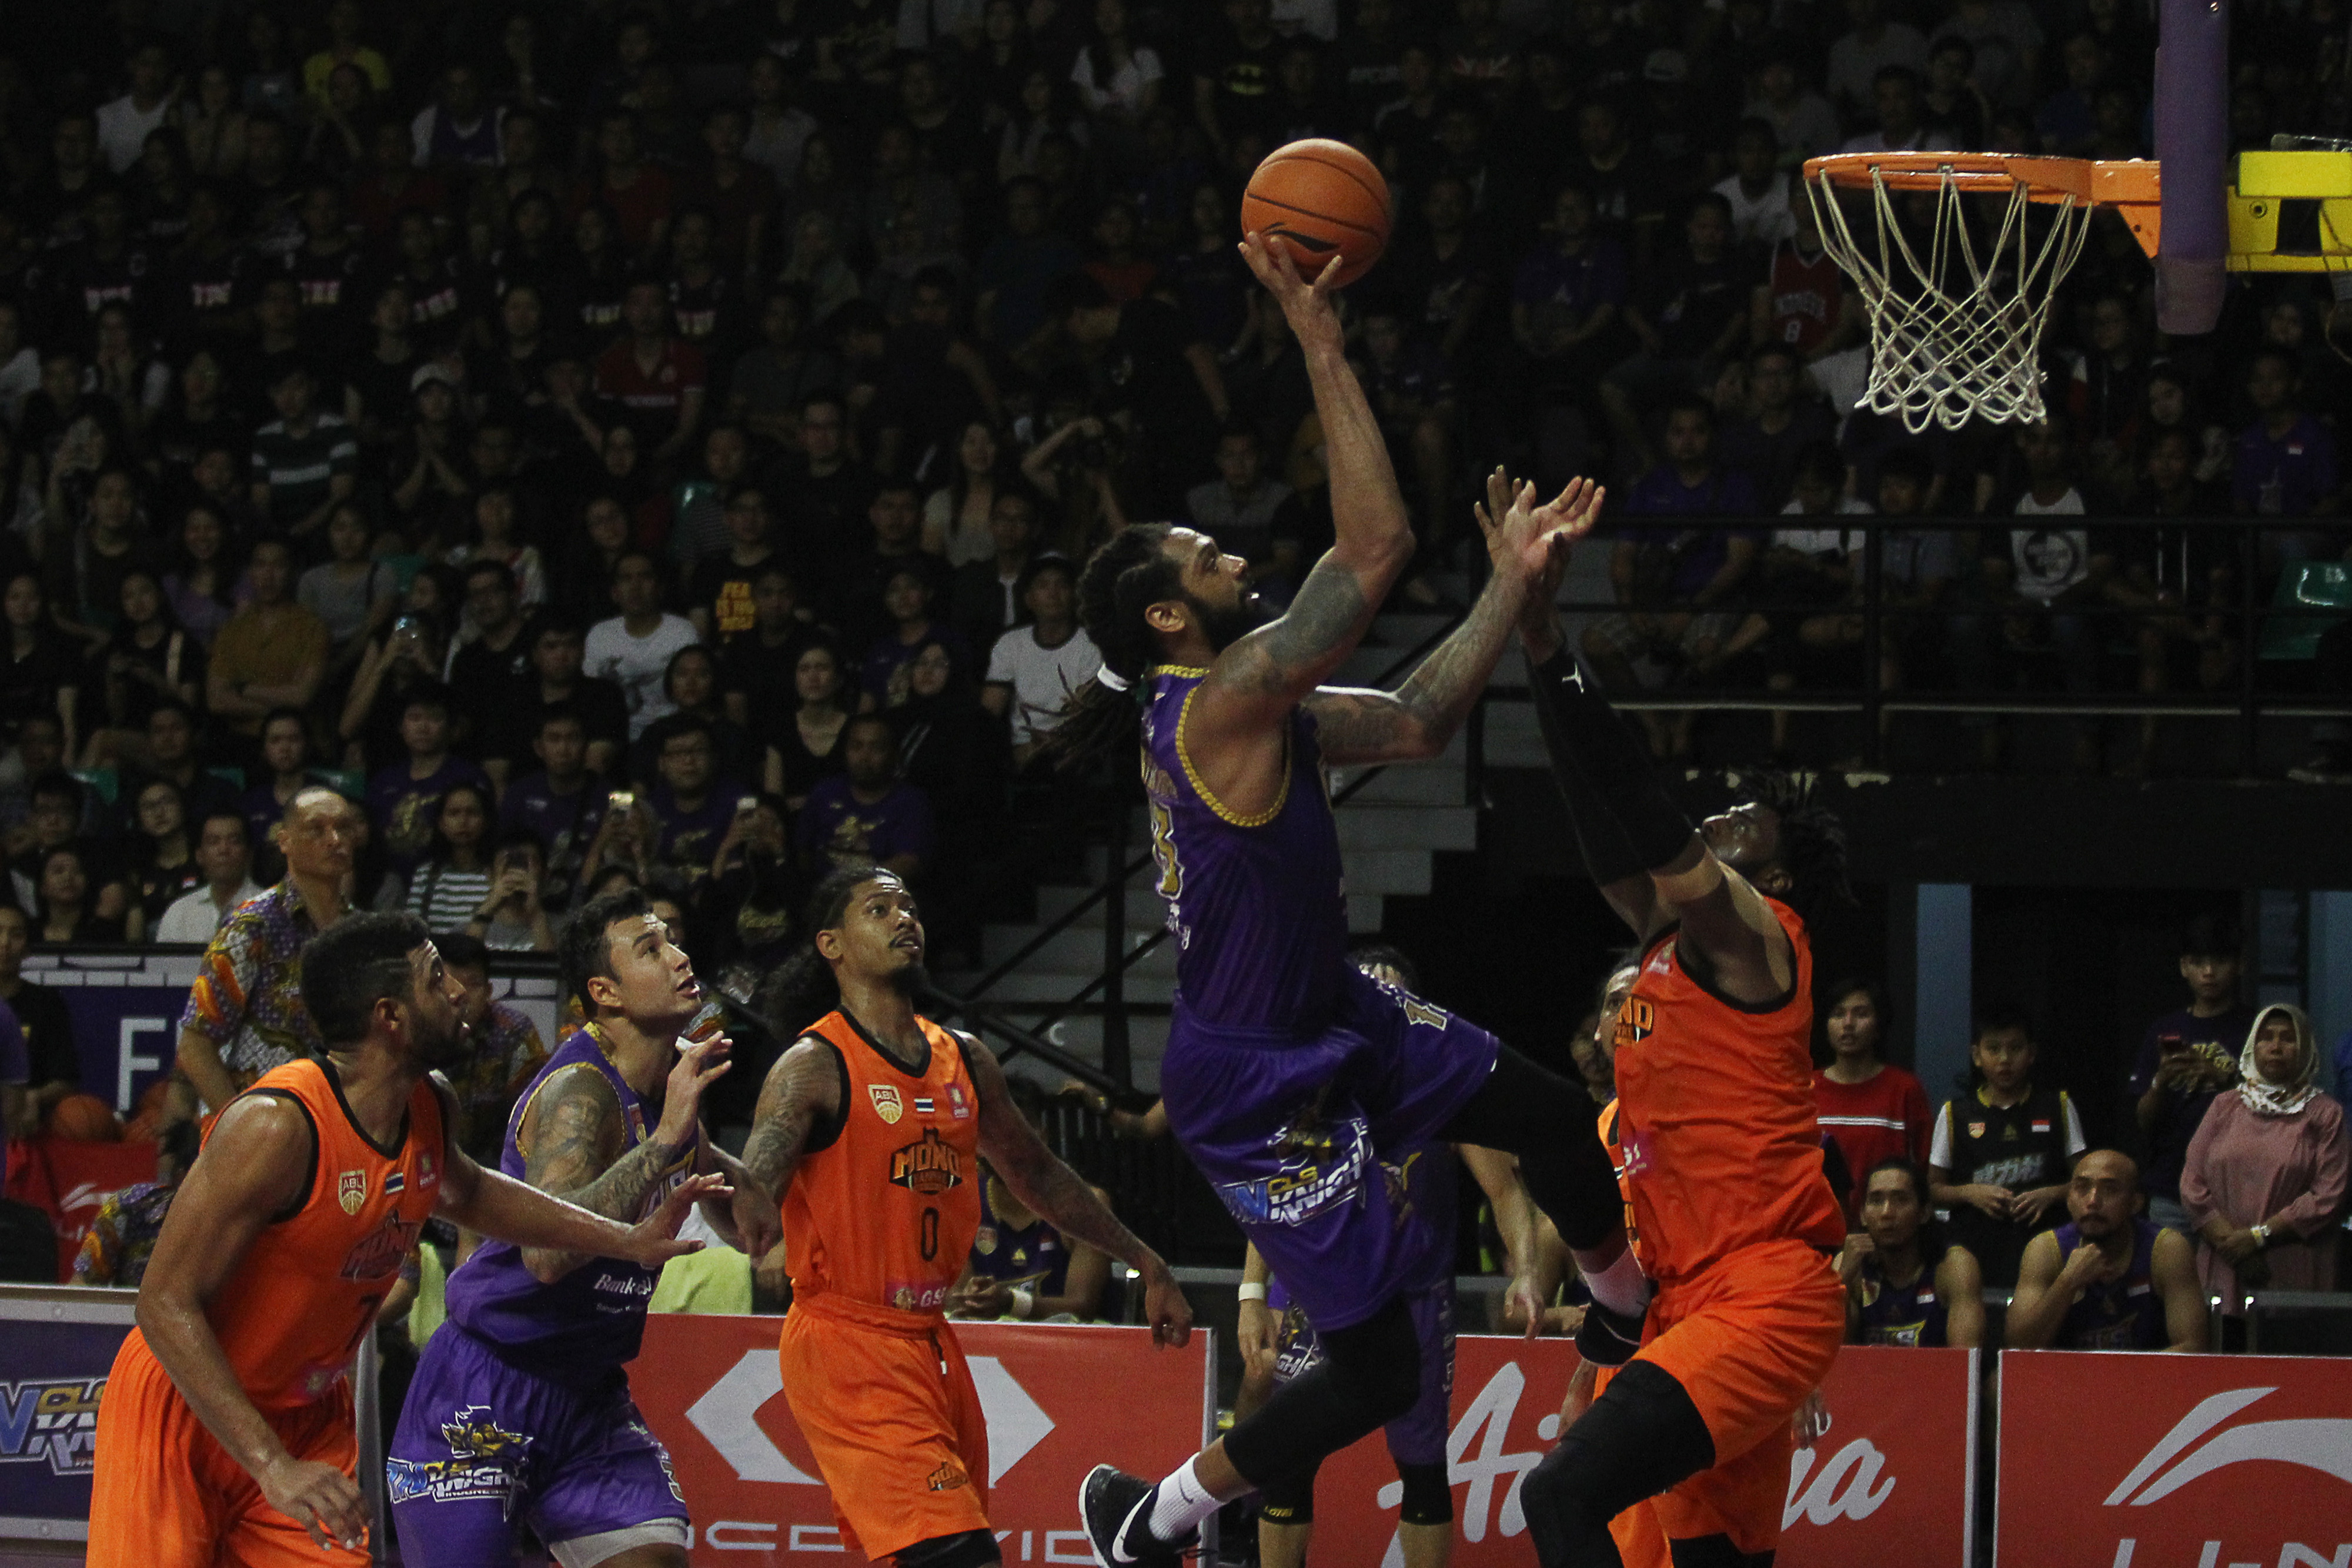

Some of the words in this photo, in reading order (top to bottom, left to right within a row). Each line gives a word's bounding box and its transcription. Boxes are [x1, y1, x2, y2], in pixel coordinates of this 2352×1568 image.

[118, 1017, 183, 1112] F
[875, 1091, 898, 1103] ABL
[891, 1144, 961, 1181] MONO
[343, 1178, 363, 1193] ABL
[921, 1207, 939, 1262] 0
[593, 1273, 636, 1295] Bank
[920, 1286, 948, 1308] GS
[1377, 1361, 1896, 1568] Aiia
